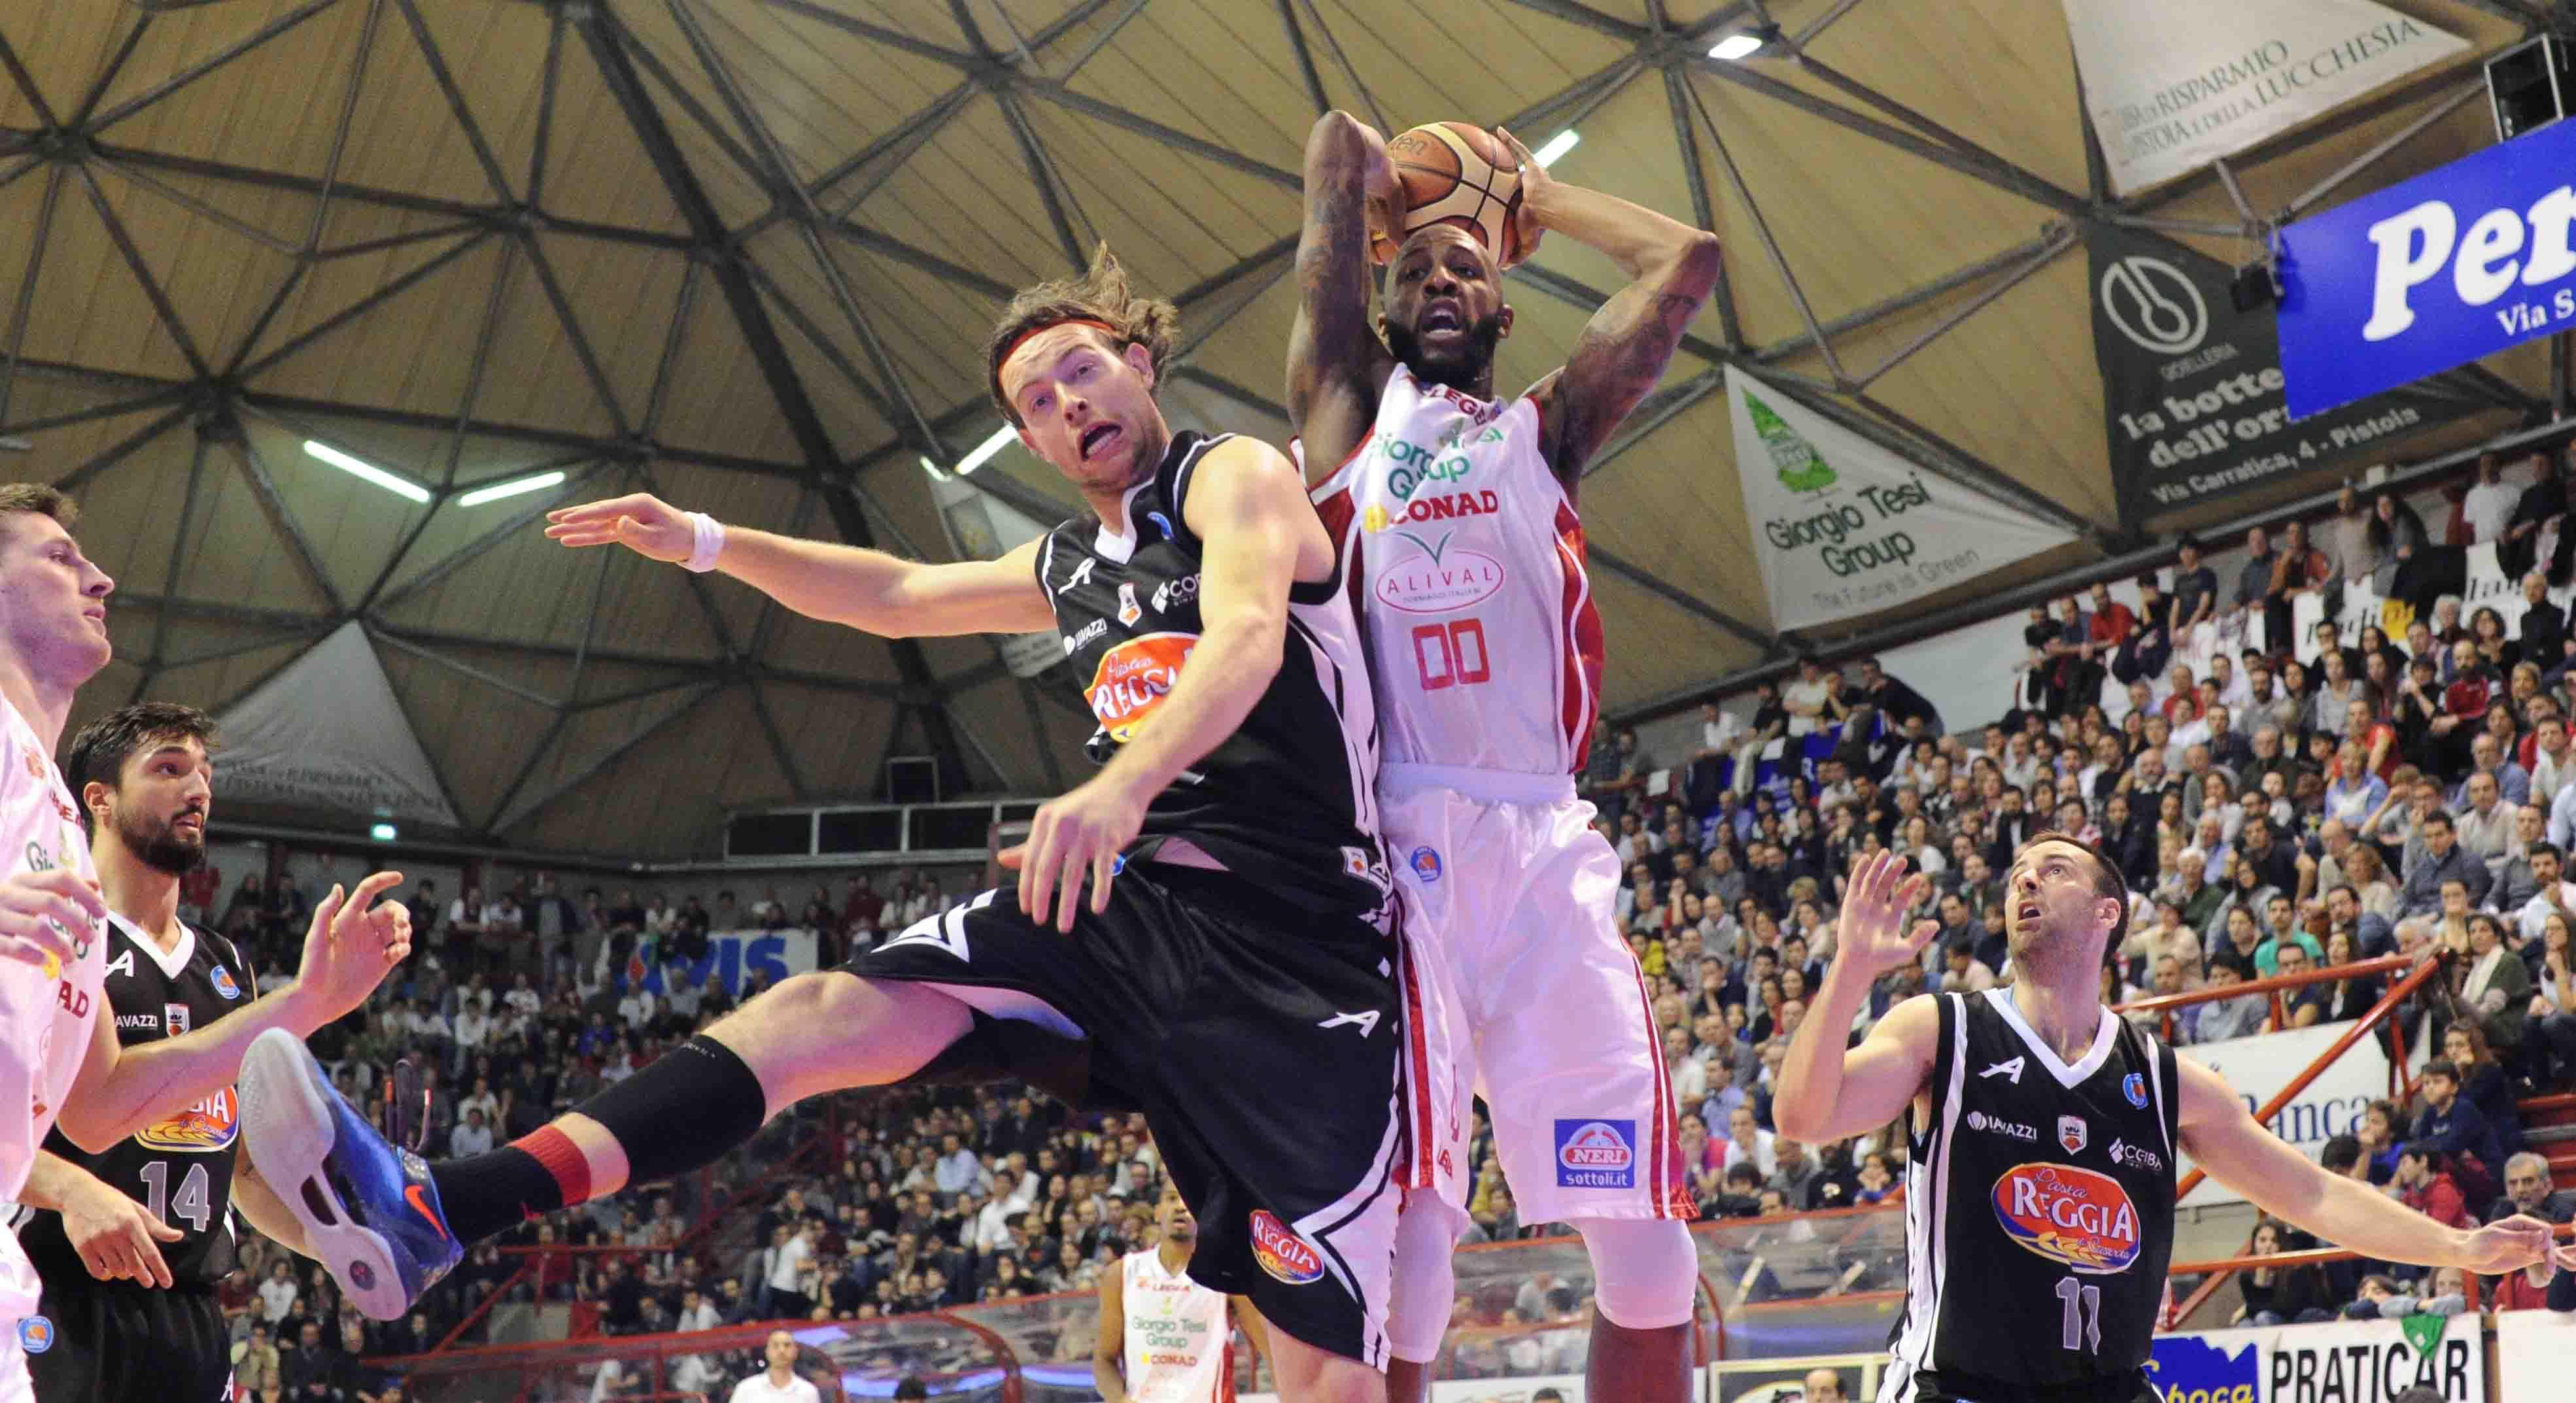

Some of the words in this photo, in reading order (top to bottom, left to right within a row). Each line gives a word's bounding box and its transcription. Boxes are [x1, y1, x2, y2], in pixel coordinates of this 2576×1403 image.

[2155, 38, 2288, 118] RISPARMIO
[2254, 18, 2422, 107] LUCCHESIA
[2496, 303, 2547, 337] Via
[2119, 411, 2165, 439] la
[2152, 482, 2190, 504] Via
[2299, 439, 2316, 458] 4
[2329, 408, 2420, 448] Pistoia
[1392, 490, 1499, 525] ONAD
[1766, 502, 1865, 549] Giorgio
[1856, 470, 1932, 518] Tesi
[1821, 531, 1915, 577] Group
[1918, 550, 1980, 582] Green
[1388, 567, 1493, 594] ALIVAL
[1413, 617, 1490, 691] 00
[1566, 1172, 1628, 1187] sottoli.it
[1573, 1148, 1623, 1164] NERI
[139, 1161, 211, 1232] 14
[2035, 1168, 2088, 1198] Pasta
[2012, 1176, 2135, 1243] REGGIA
[1254, 1215, 1316, 1270] REGGIA
[1146, 1332, 1188, 1350] Group
[2055, 1276, 2101, 1356] 11
[2271, 1339, 2469, 1403] PRATICAR
